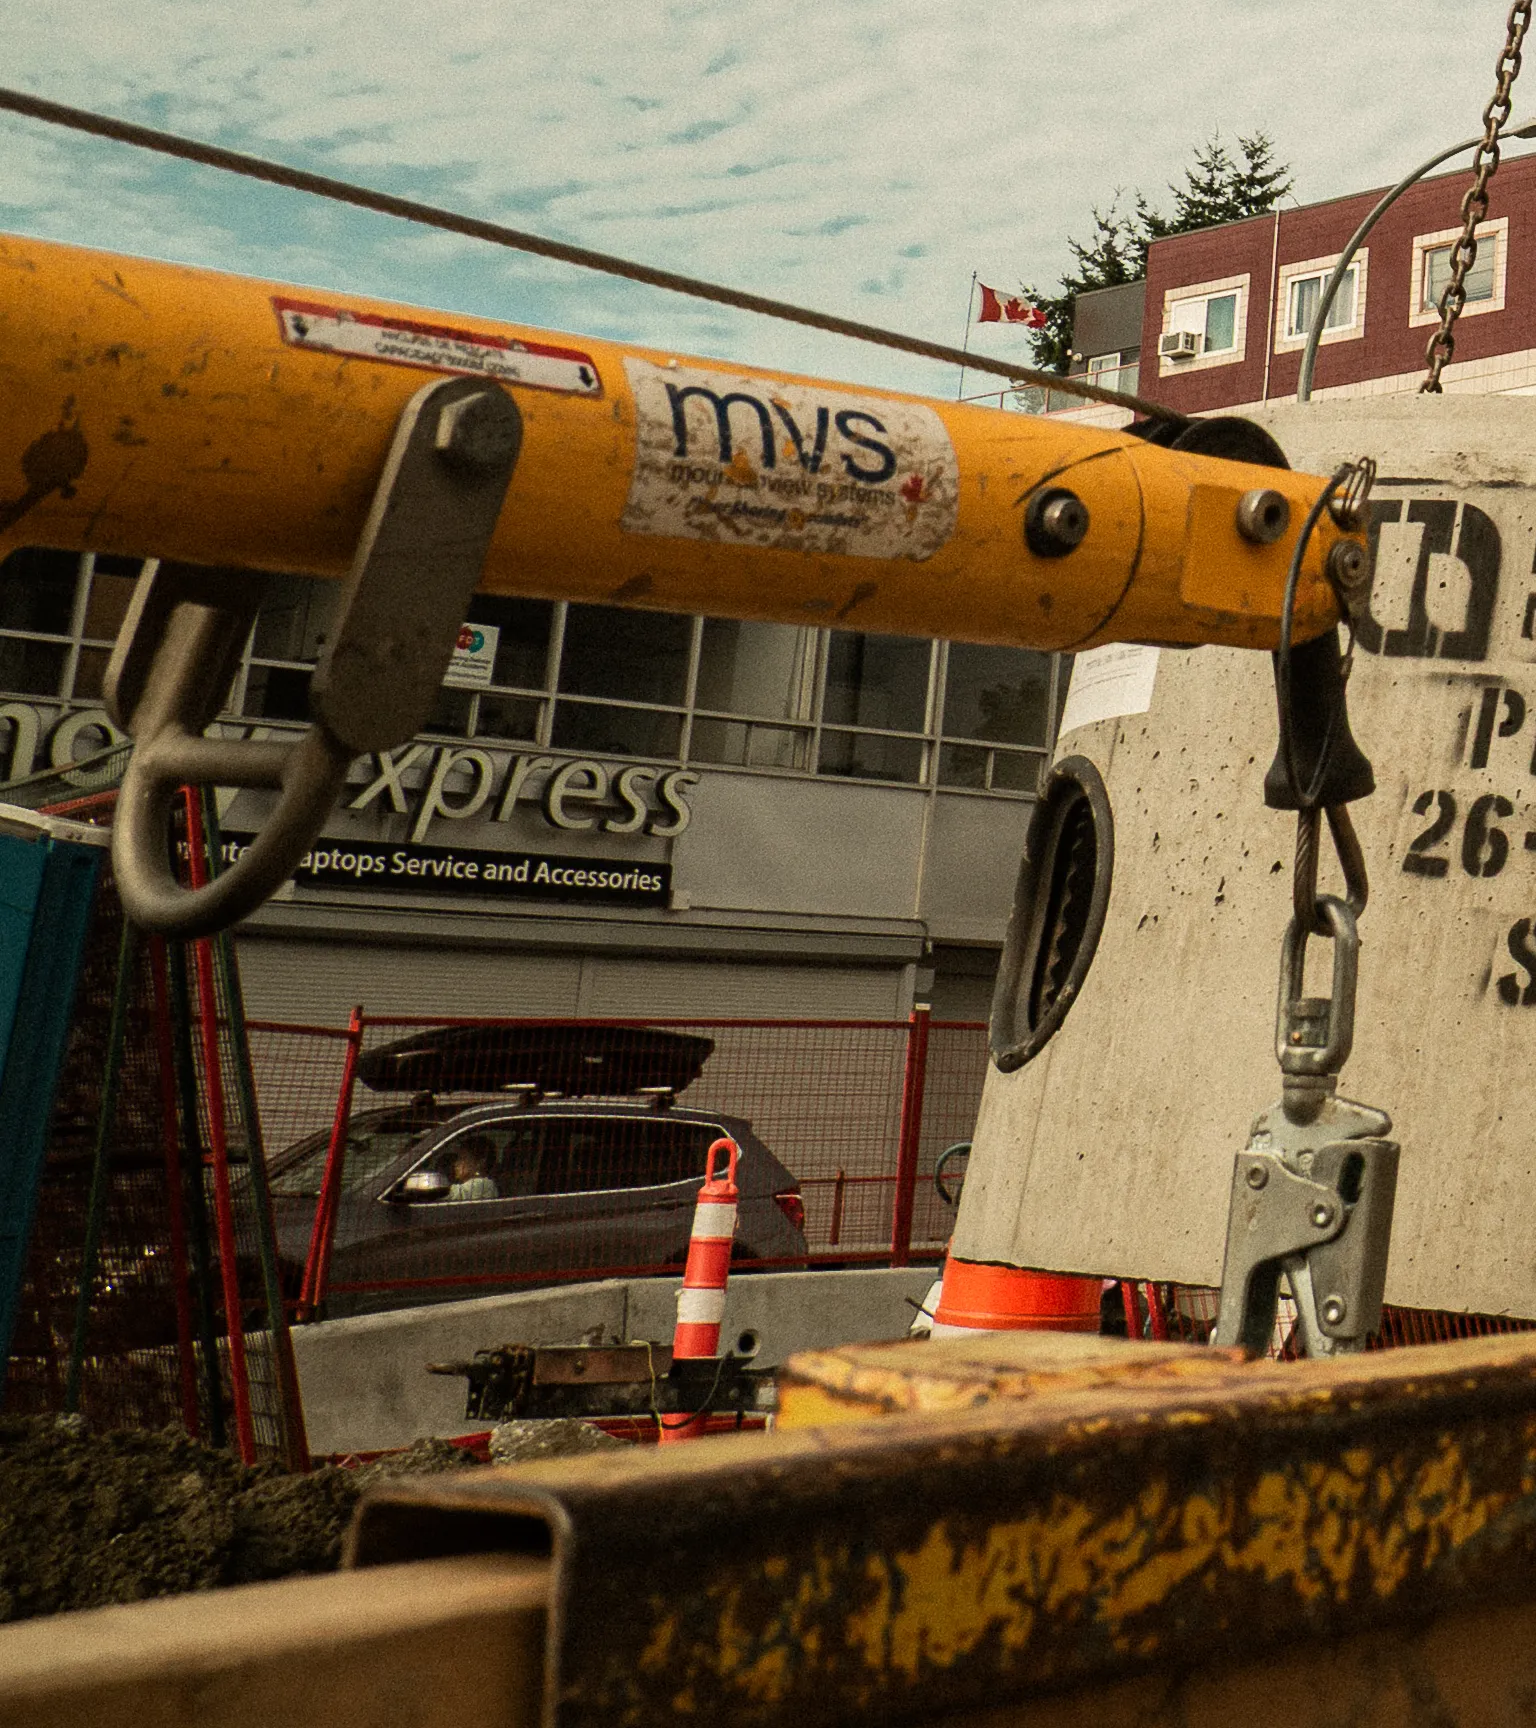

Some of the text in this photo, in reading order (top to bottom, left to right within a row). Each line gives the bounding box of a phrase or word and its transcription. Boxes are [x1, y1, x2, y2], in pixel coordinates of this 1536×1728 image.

[665, 382, 897, 484] mvs
[393, 852, 479, 883] Service
[484, 858, 530, 885] and
[534, 861, 662, 892] Accessories
